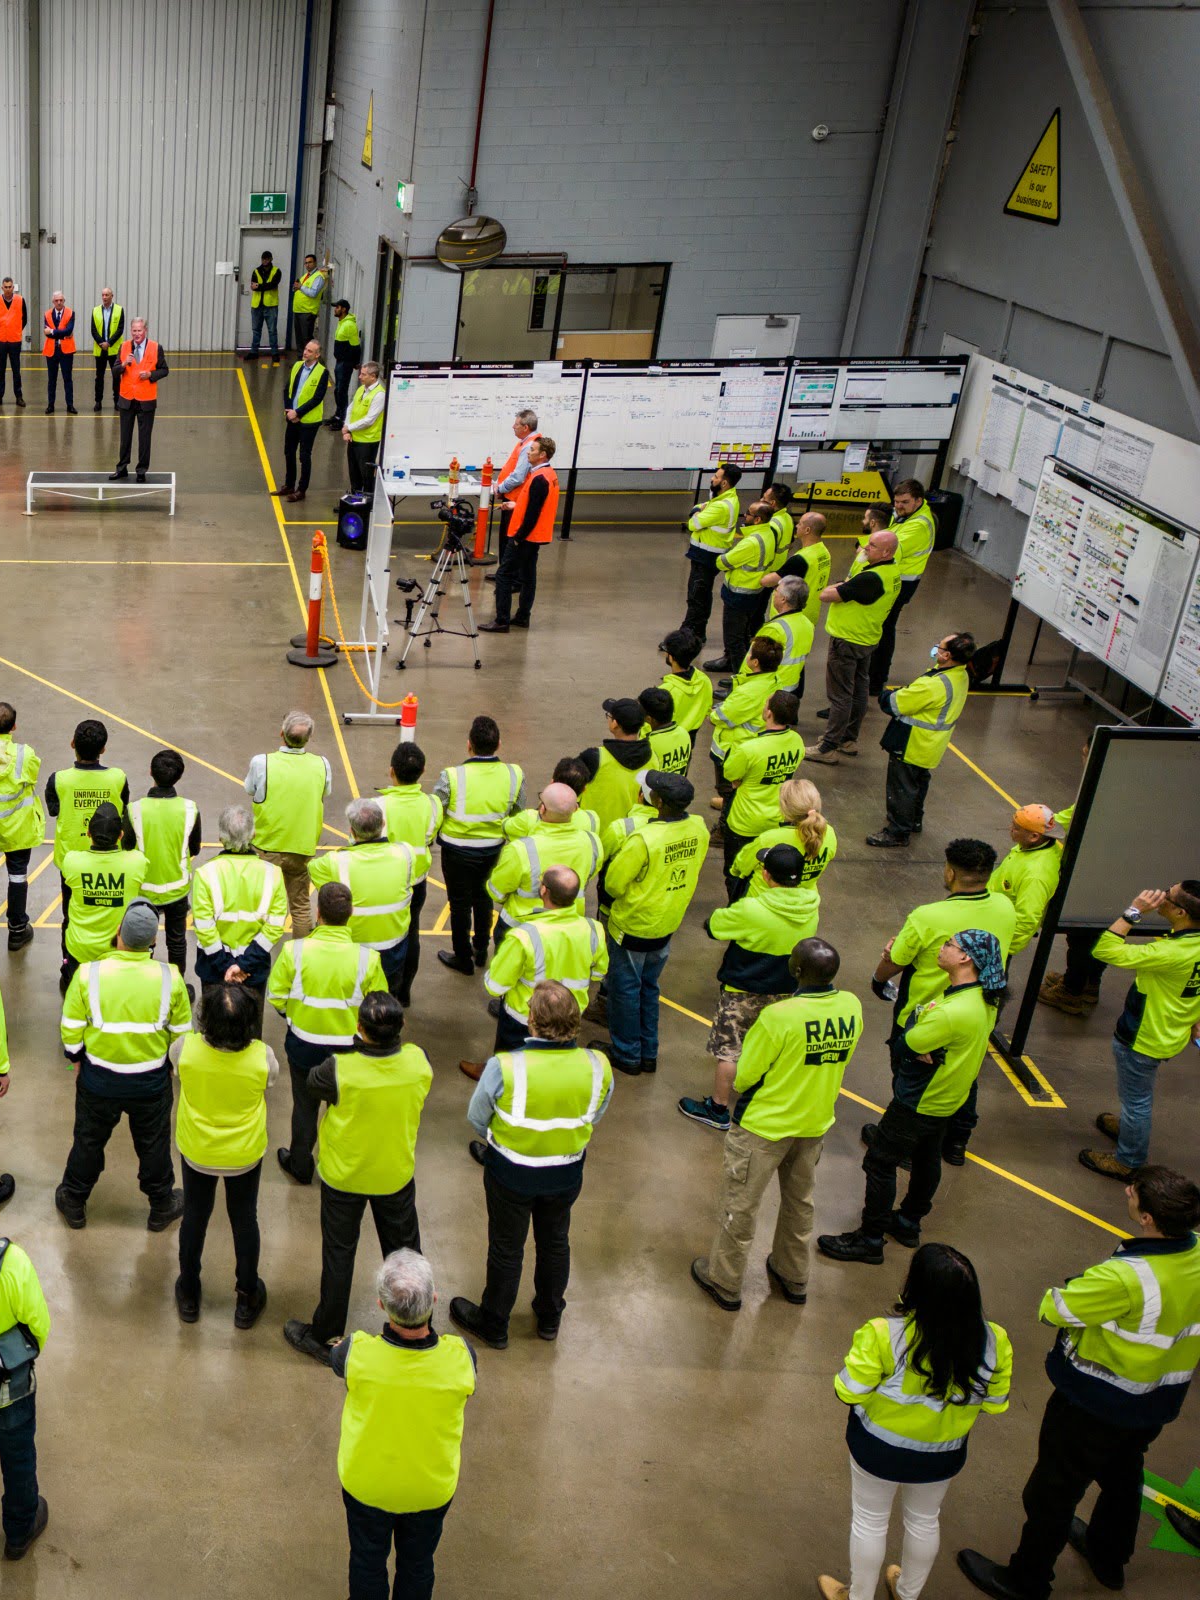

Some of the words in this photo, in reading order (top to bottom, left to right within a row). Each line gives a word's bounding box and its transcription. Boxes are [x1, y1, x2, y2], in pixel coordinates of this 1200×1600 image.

[1029, 162, 1056, 177] SAFETY
[1029, 180, 1035, 191] is
[1036, 184, 1047, 193] our
[1016, 193, 1042, 208] business
[1042, 199, 1053, 210] too
[840, 475, 850, 485] is
[825, 488, 881, 499] accident
[663, 743, 690, 769] RAM
[767, 749, 800, 772] RAM
[764, 765, 796, 777] DOMINATION
[73, 790, 111, 799] UNRIVALLED
[664, 838, 698, 854] UNRIVALLED
[664, 847, 698, 864] EVERYDAY
[81, 872, 125, 890] RAM
[82, 889, 124, 898] DOMINATION
[94, 897, 113, 907] CREW
[805, 1015, 856, 1043] RAM
[806, 1039, 854, 1052] DOMINATION
[820, 1052, 840, 1064] CREW
